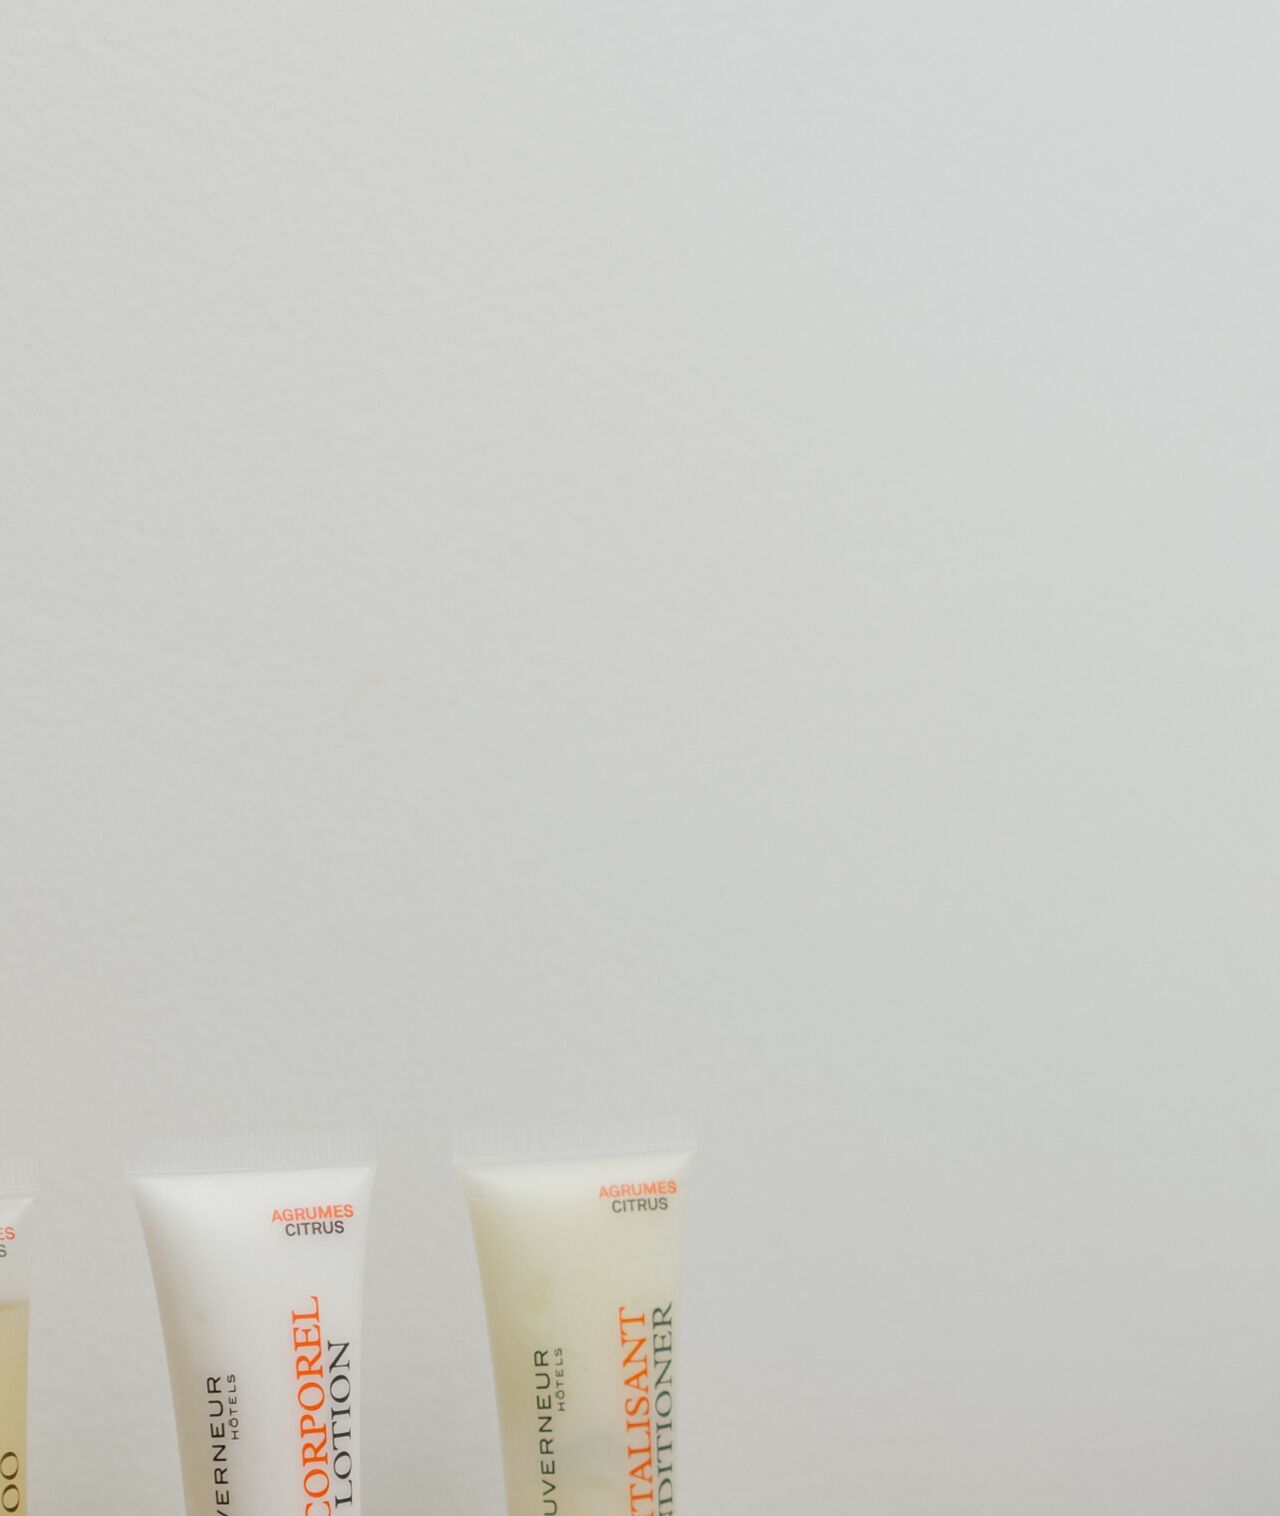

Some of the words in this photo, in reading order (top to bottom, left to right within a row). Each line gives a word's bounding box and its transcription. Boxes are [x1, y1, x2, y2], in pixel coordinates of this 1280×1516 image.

[599, 1180, 677, 1198] AGRUMES
[272, 1204, 354, 1222] AGRUMES
[612, 1197, 668, 1213] CITRUS
[285, 1220, 344, 1236] CITRUS
[554, 1348, 566, 1412] HÔTELS
[227, 1374, 239, 1440] HÔTELS
[328, 1339, 353, 1506] LOTION
